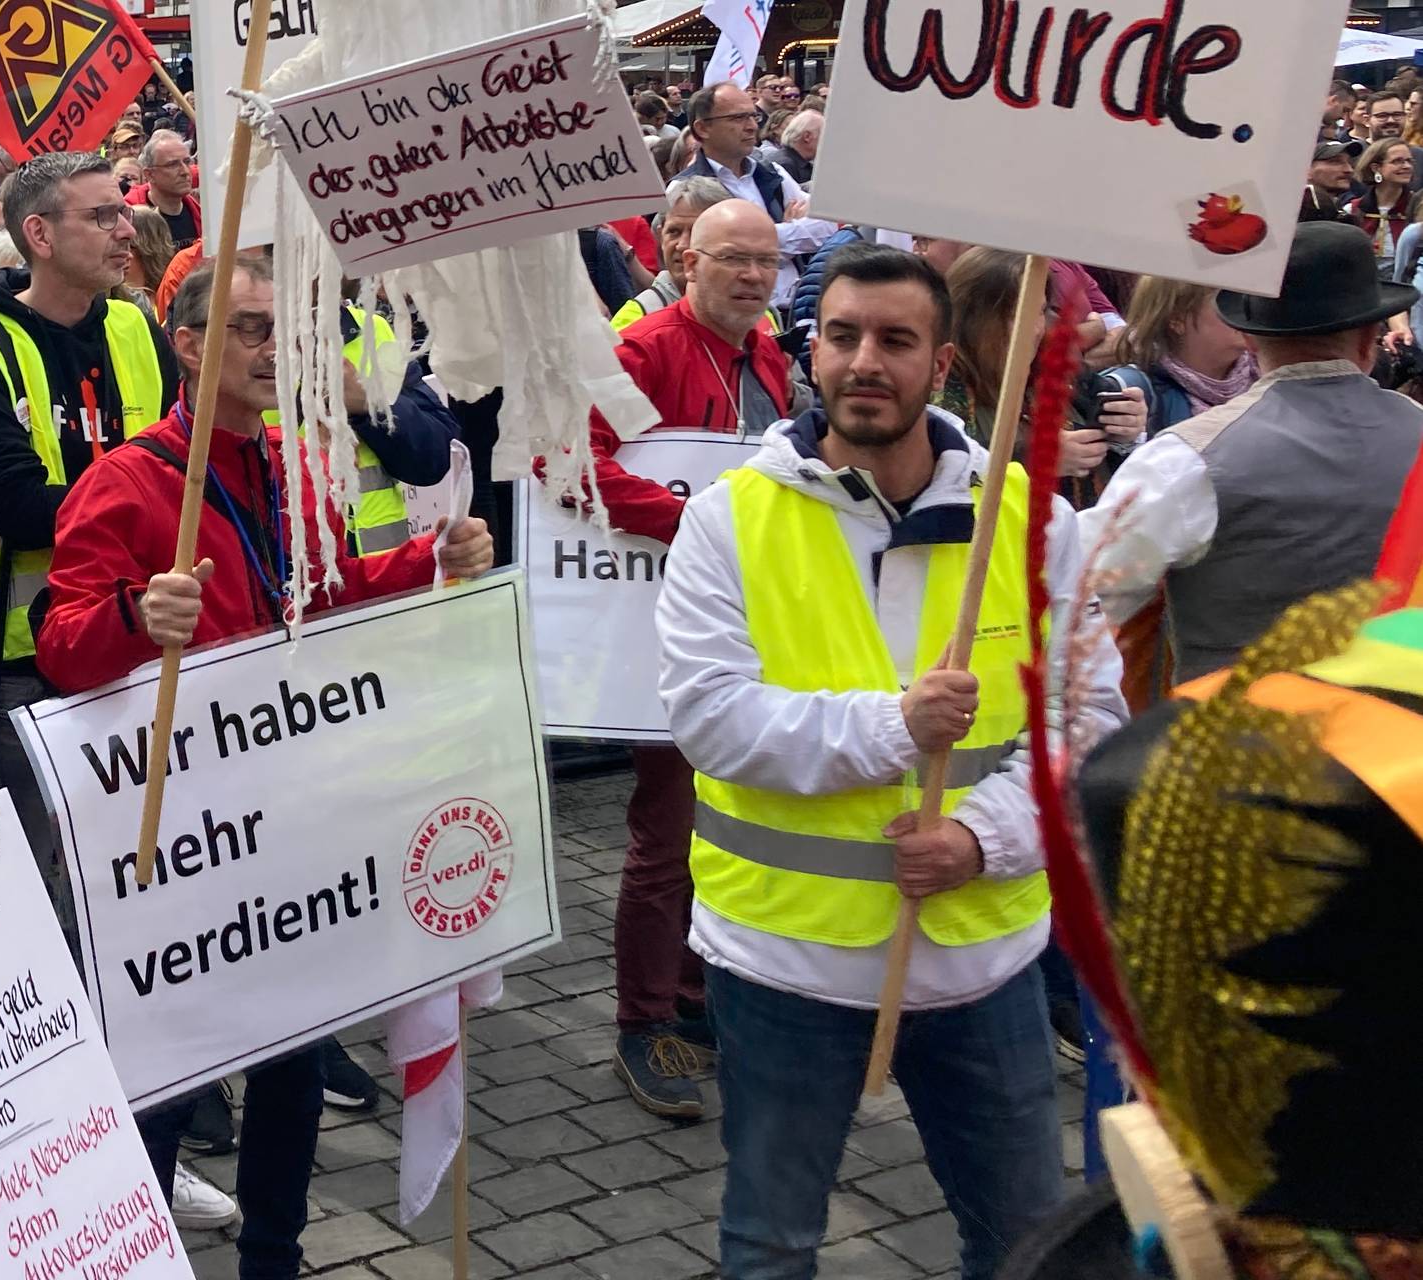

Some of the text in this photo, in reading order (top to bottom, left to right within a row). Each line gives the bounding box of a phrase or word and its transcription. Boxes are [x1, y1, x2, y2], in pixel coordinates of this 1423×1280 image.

[280, 40, 573, 153] Ich bin der Geist
[308, 162, 356, 199] der
[460, 97, 608, 160] Arbeitsbe-
[330, 136, 637, 244] dingungen im Handel
[554, 540, 668, 581] Han
[210, 671, 386, 759] haben
[111, 809, 264, 900] mehr
[411, 806, 504, 873] OHNE UNS KEIN
[432, 850, 486, 885] ver.di
[124, 855, 380, 997] verdient!
[6, 998, 79, 1064] Unterhalt)
[8, 1207, 59, 1258] Strom
